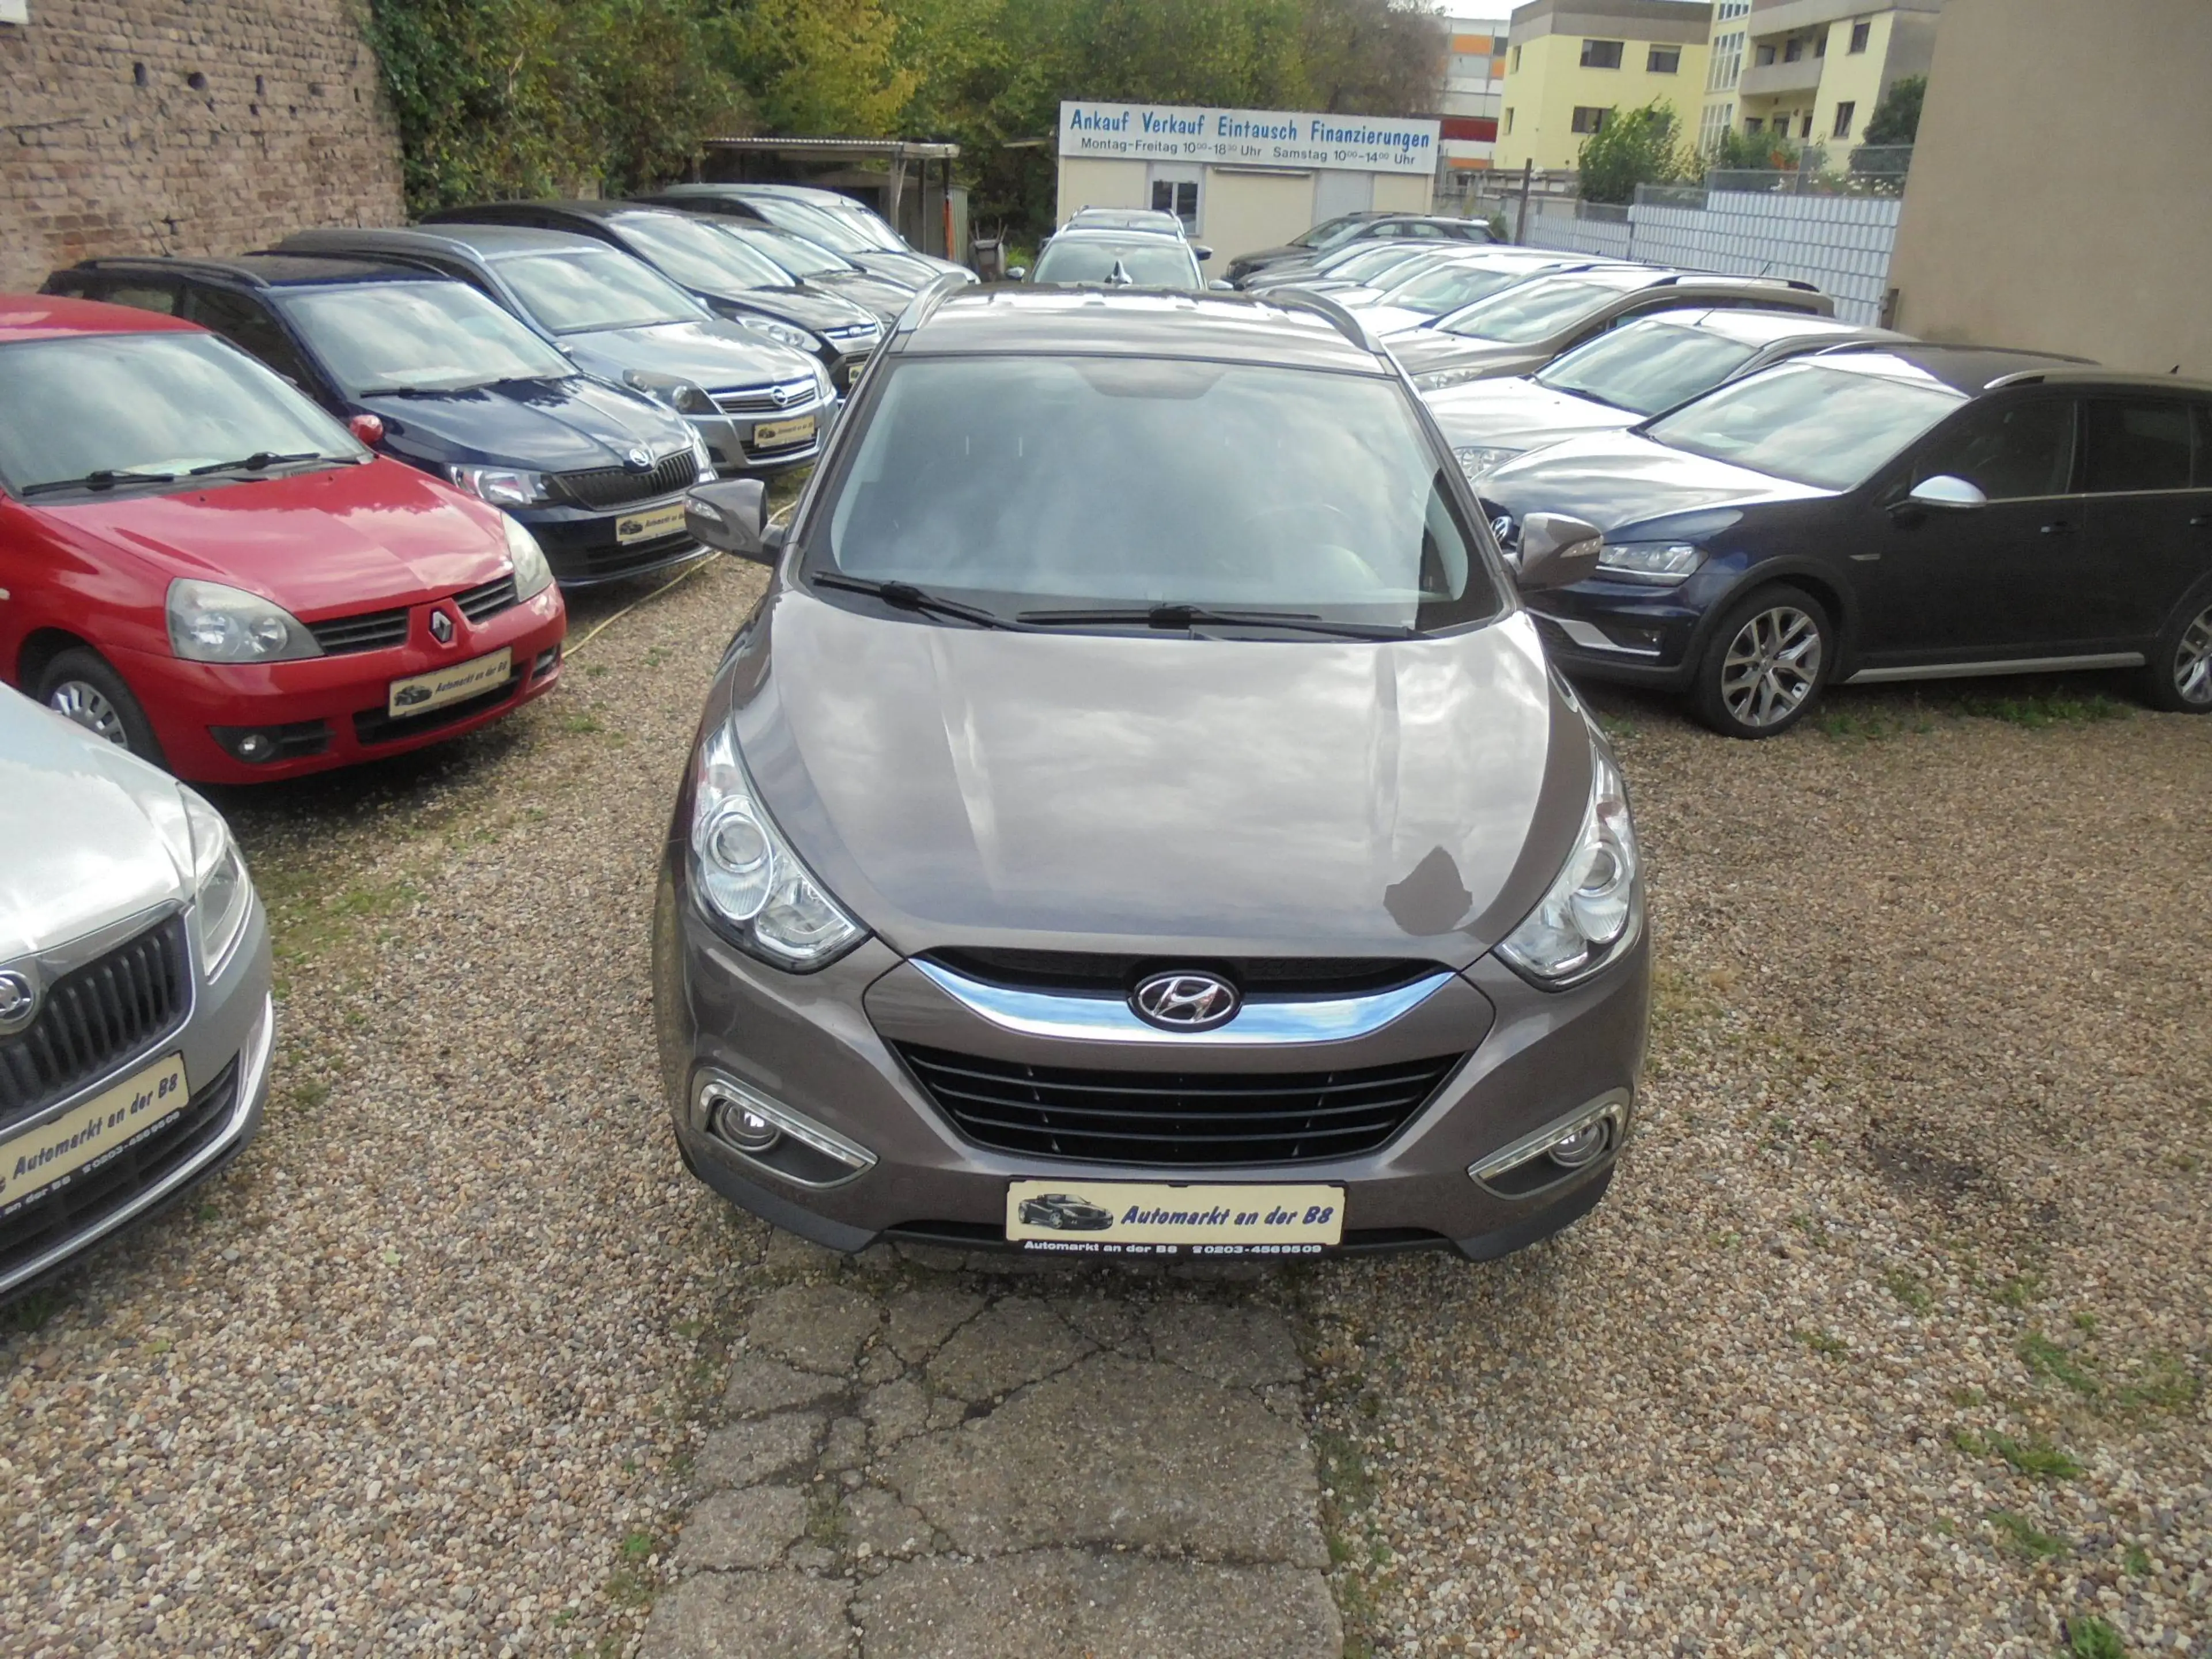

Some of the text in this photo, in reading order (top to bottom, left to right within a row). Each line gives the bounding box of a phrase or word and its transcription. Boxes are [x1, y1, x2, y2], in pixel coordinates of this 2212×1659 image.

[1070, 109, 1430, 153] Ankauf Verkauf Eintausch Finanzierungen
[1081, 137, 1177, 154] Montag-Freitag
[1241, 145, 1262, 156] Uhr
[1273, 146, 1327, 162] Samstag
[1394, 154, 1415, 165] Uhr
[13, 1073, 178, 1180] Automarkt an der B8
[1120, 1205, 1334, 1225] Automarkt an der B8
[1024, 1240, 1099, 1252] Automarkt
[1103, 1244, 1122, 1252] an
[1126, 1245, 1152, 1253] der
